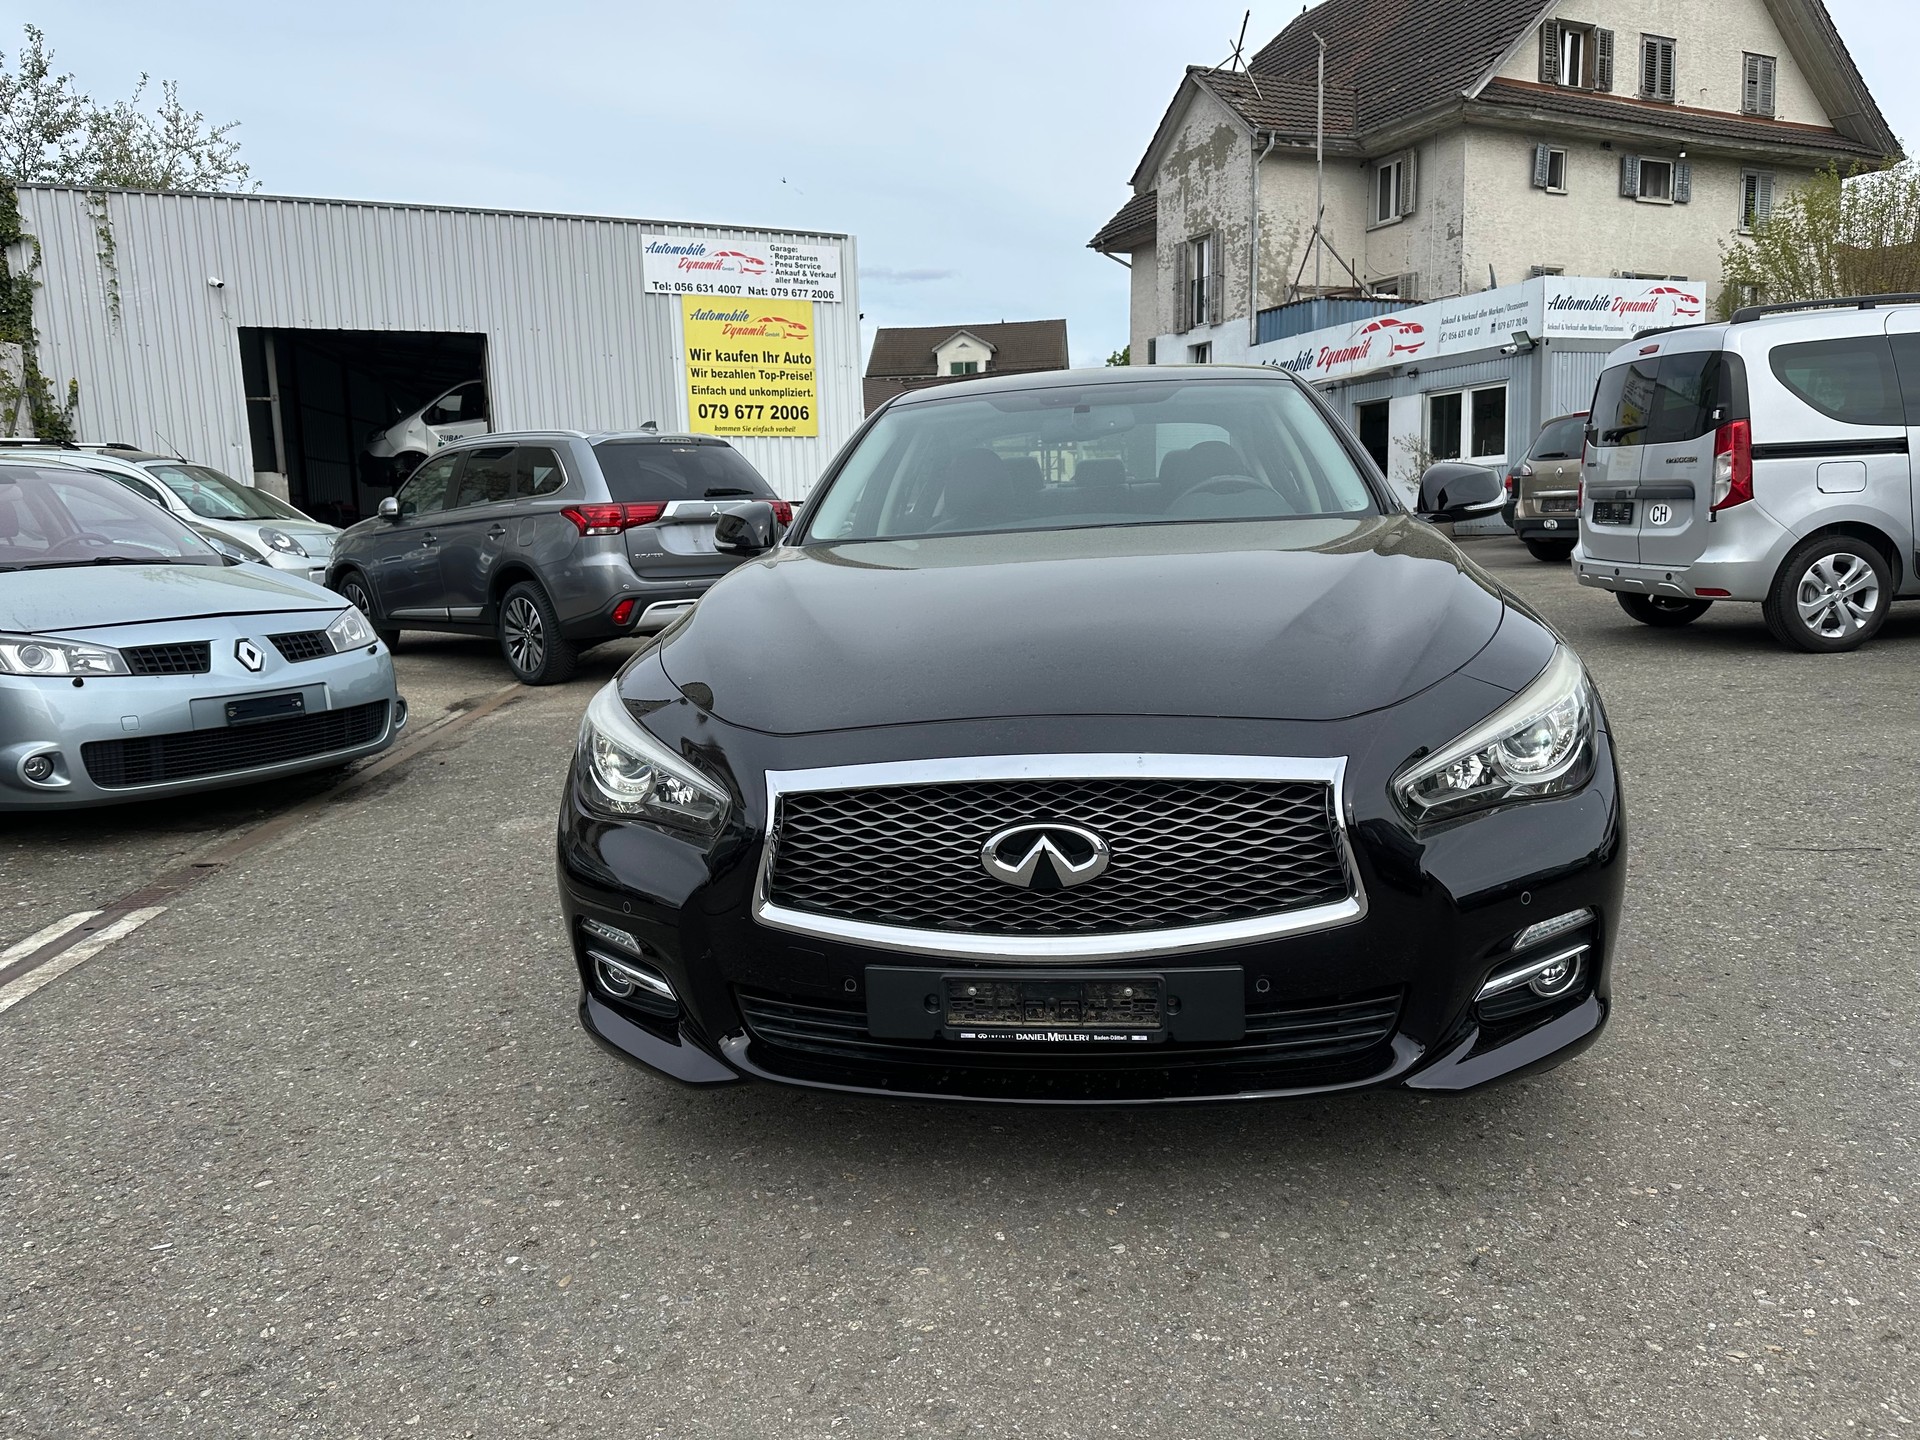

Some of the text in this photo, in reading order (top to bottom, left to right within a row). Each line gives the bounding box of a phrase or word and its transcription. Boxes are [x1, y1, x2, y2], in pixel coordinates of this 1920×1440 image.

[645, 241, 706, 256] Automobile
[769, 244, 798, 254] Garage:
[774, 252, 818, 262] Reparaturen
[678, 257, 724, 273] Dynamik
[794, 262, 822, 270] Service
[775, 268, 800, 277] Ankauf
[809, 270, 836, 278] Verkauf
[792, 278, 819, 286] Marken
[652, 281, 834, 299] Tel: 056 631 4007 Nat: 079 677 2006
[1548, 294, 1658, 317] Automobile Dynamik
[690, 308, 750, 322] Automobile
[722, 324, 767, 339] Dynamik
[1448, 332, 1457, 340] 056
[1498, 322, 1506, 330] 079
[690, 348, 812, 364] Wir kaufen Ihr Auto
[1316, 336, 1372, 374] Dynamik
[690, 368, 813, 382] Wir bezahlen Top-Preise!
[692, 385, 814, 398] Einfach und unkompliziert.
[698, 404, 810, 420] 079 677 2006
[752, 425, 774, 433] einfach
[1652, 506, 1668, 522] CH
